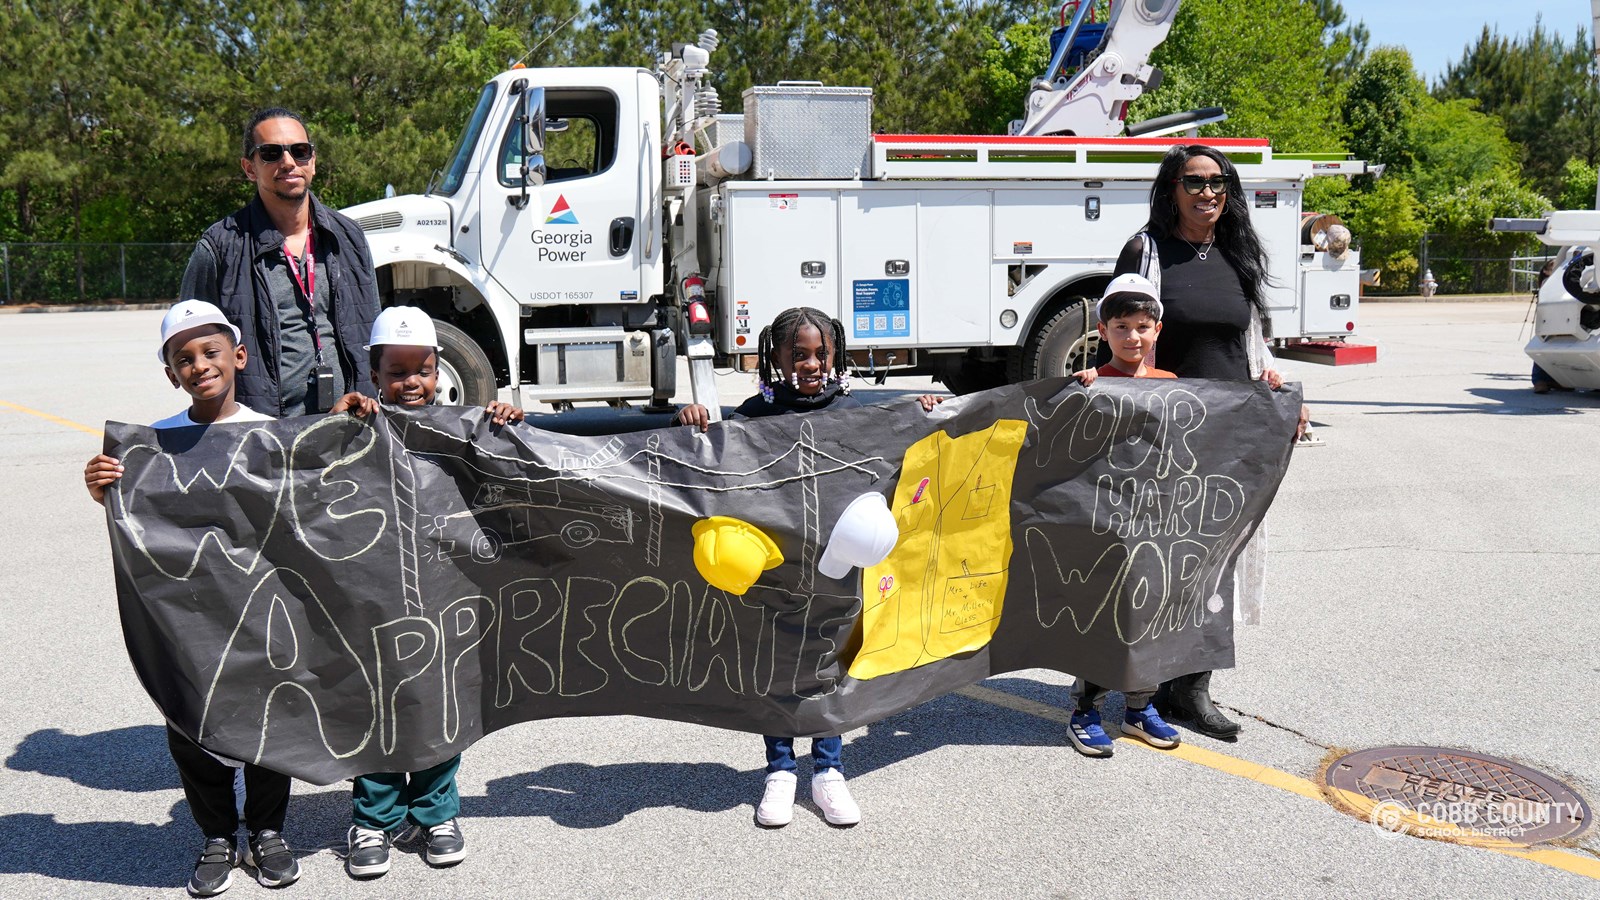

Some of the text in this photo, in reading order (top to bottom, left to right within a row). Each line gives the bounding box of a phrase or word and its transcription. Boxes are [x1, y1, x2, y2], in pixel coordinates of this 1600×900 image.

[530, 229, 593, 248] Georgia
[538, 247, 586, 262] Power
[530, 292, 594, 300] USDOT 165307
[1023, 388, 1208, 480] YOUR
[118, 414, 387, 582] WE
[1091, 474, 1246, 539] HARD
[954, 613, 977, 626] Class
[199, 566, 863, 766] APPRECIATE
